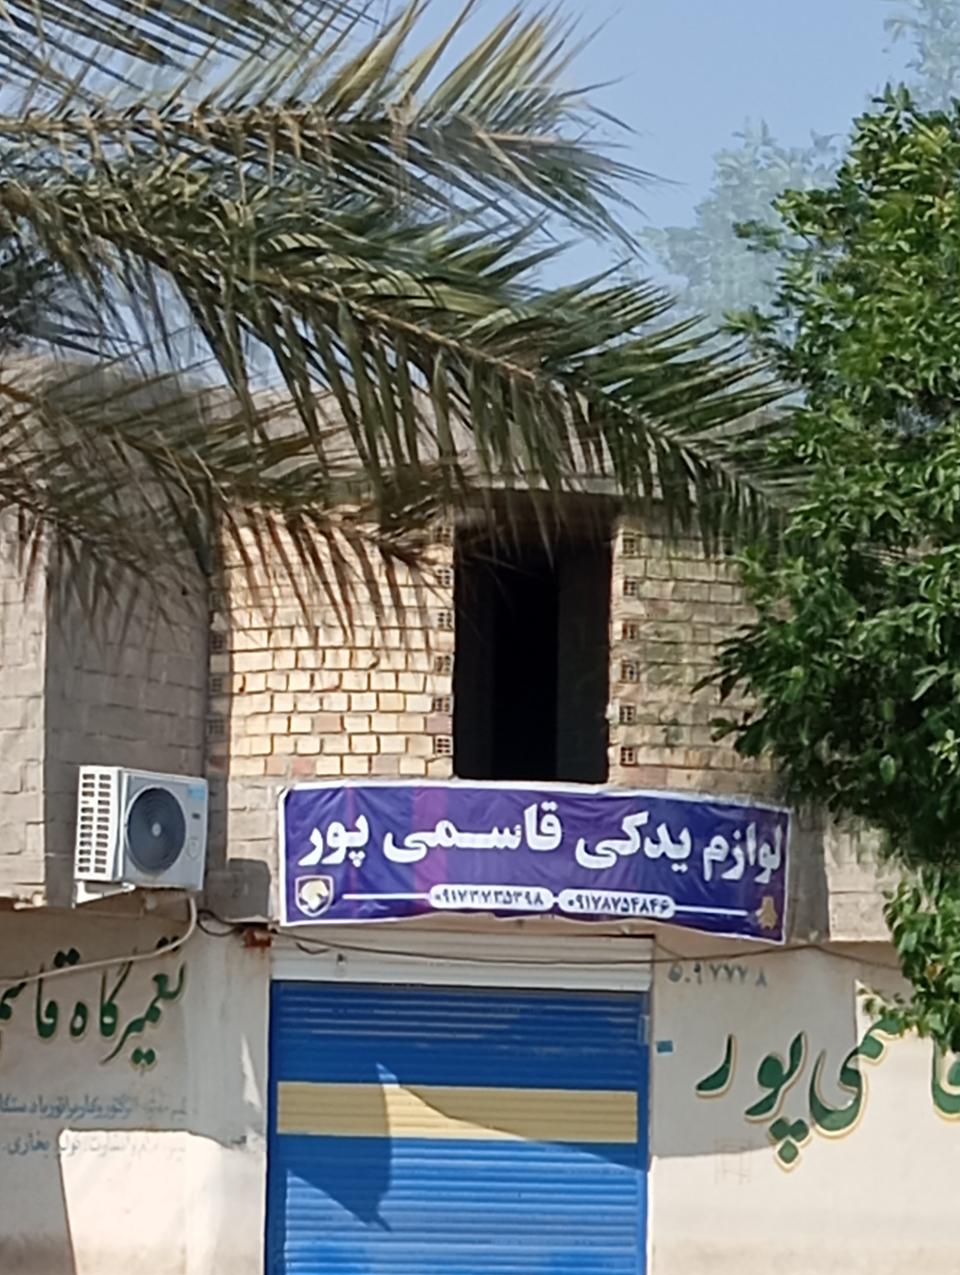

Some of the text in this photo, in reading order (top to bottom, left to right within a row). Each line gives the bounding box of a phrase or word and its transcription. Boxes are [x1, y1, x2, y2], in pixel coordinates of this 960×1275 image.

[297, 801, 783, 884] لوازم یدکی قاسمی پور
[695, 1029, 810, 1168] پور
